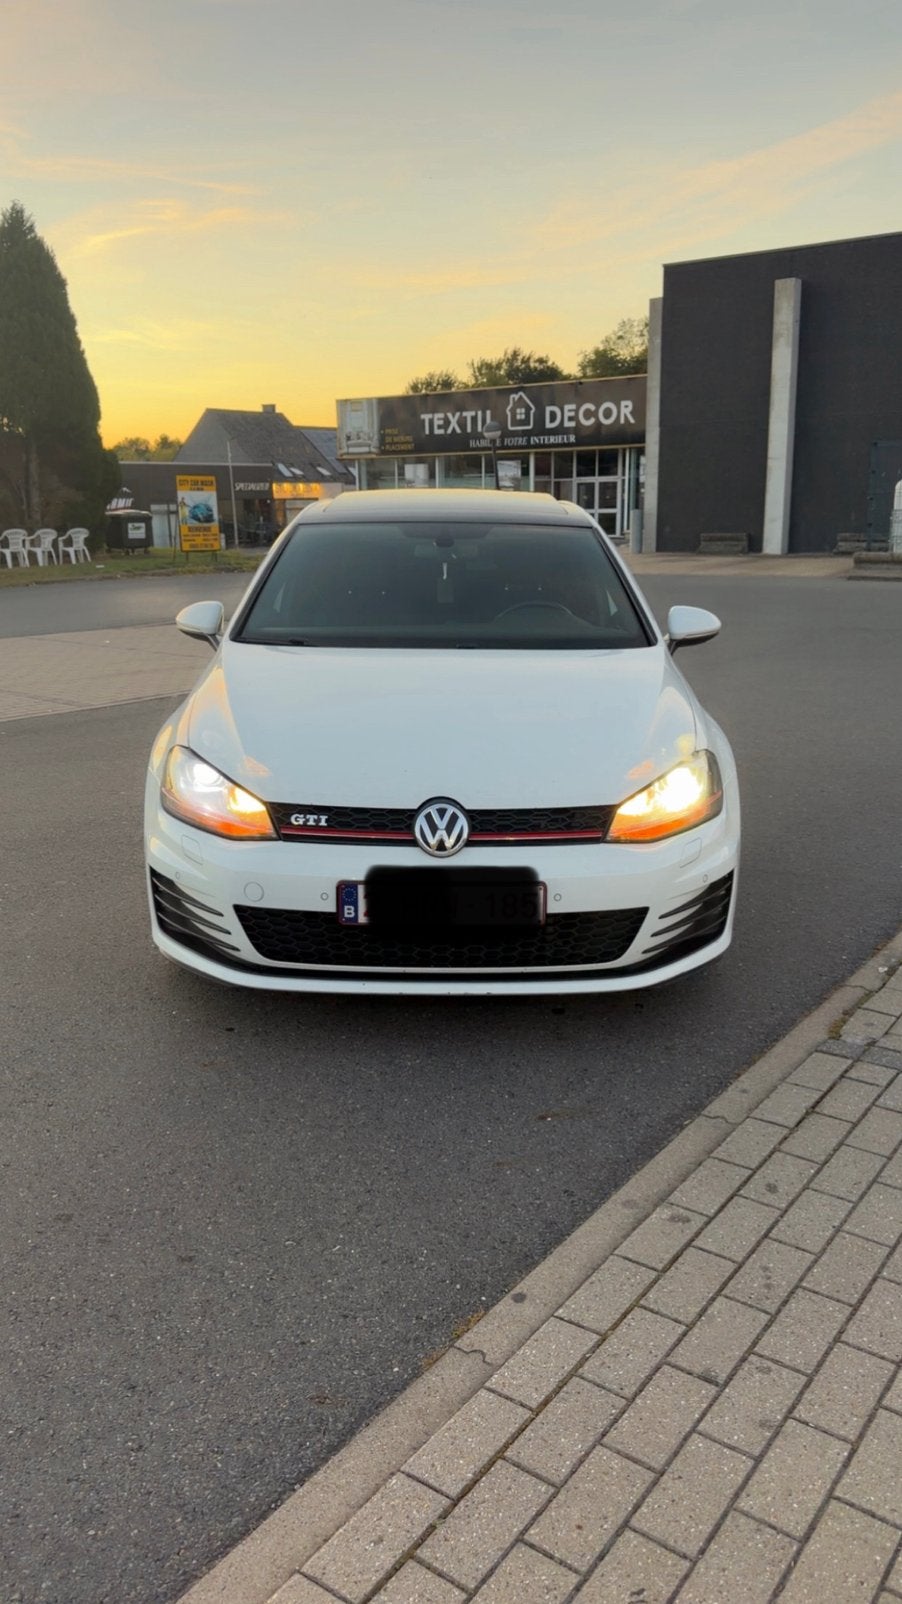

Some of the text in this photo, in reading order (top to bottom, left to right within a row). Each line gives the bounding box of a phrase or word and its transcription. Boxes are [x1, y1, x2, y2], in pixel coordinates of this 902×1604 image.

[545, 400, 635, 429] DECOR
[469, 438, 502, 448] HABILE
[530, 434, 576, 445] INTERIEUR
[290, 813, 328, 827] GTI
[343, 905, 355, 918] B
